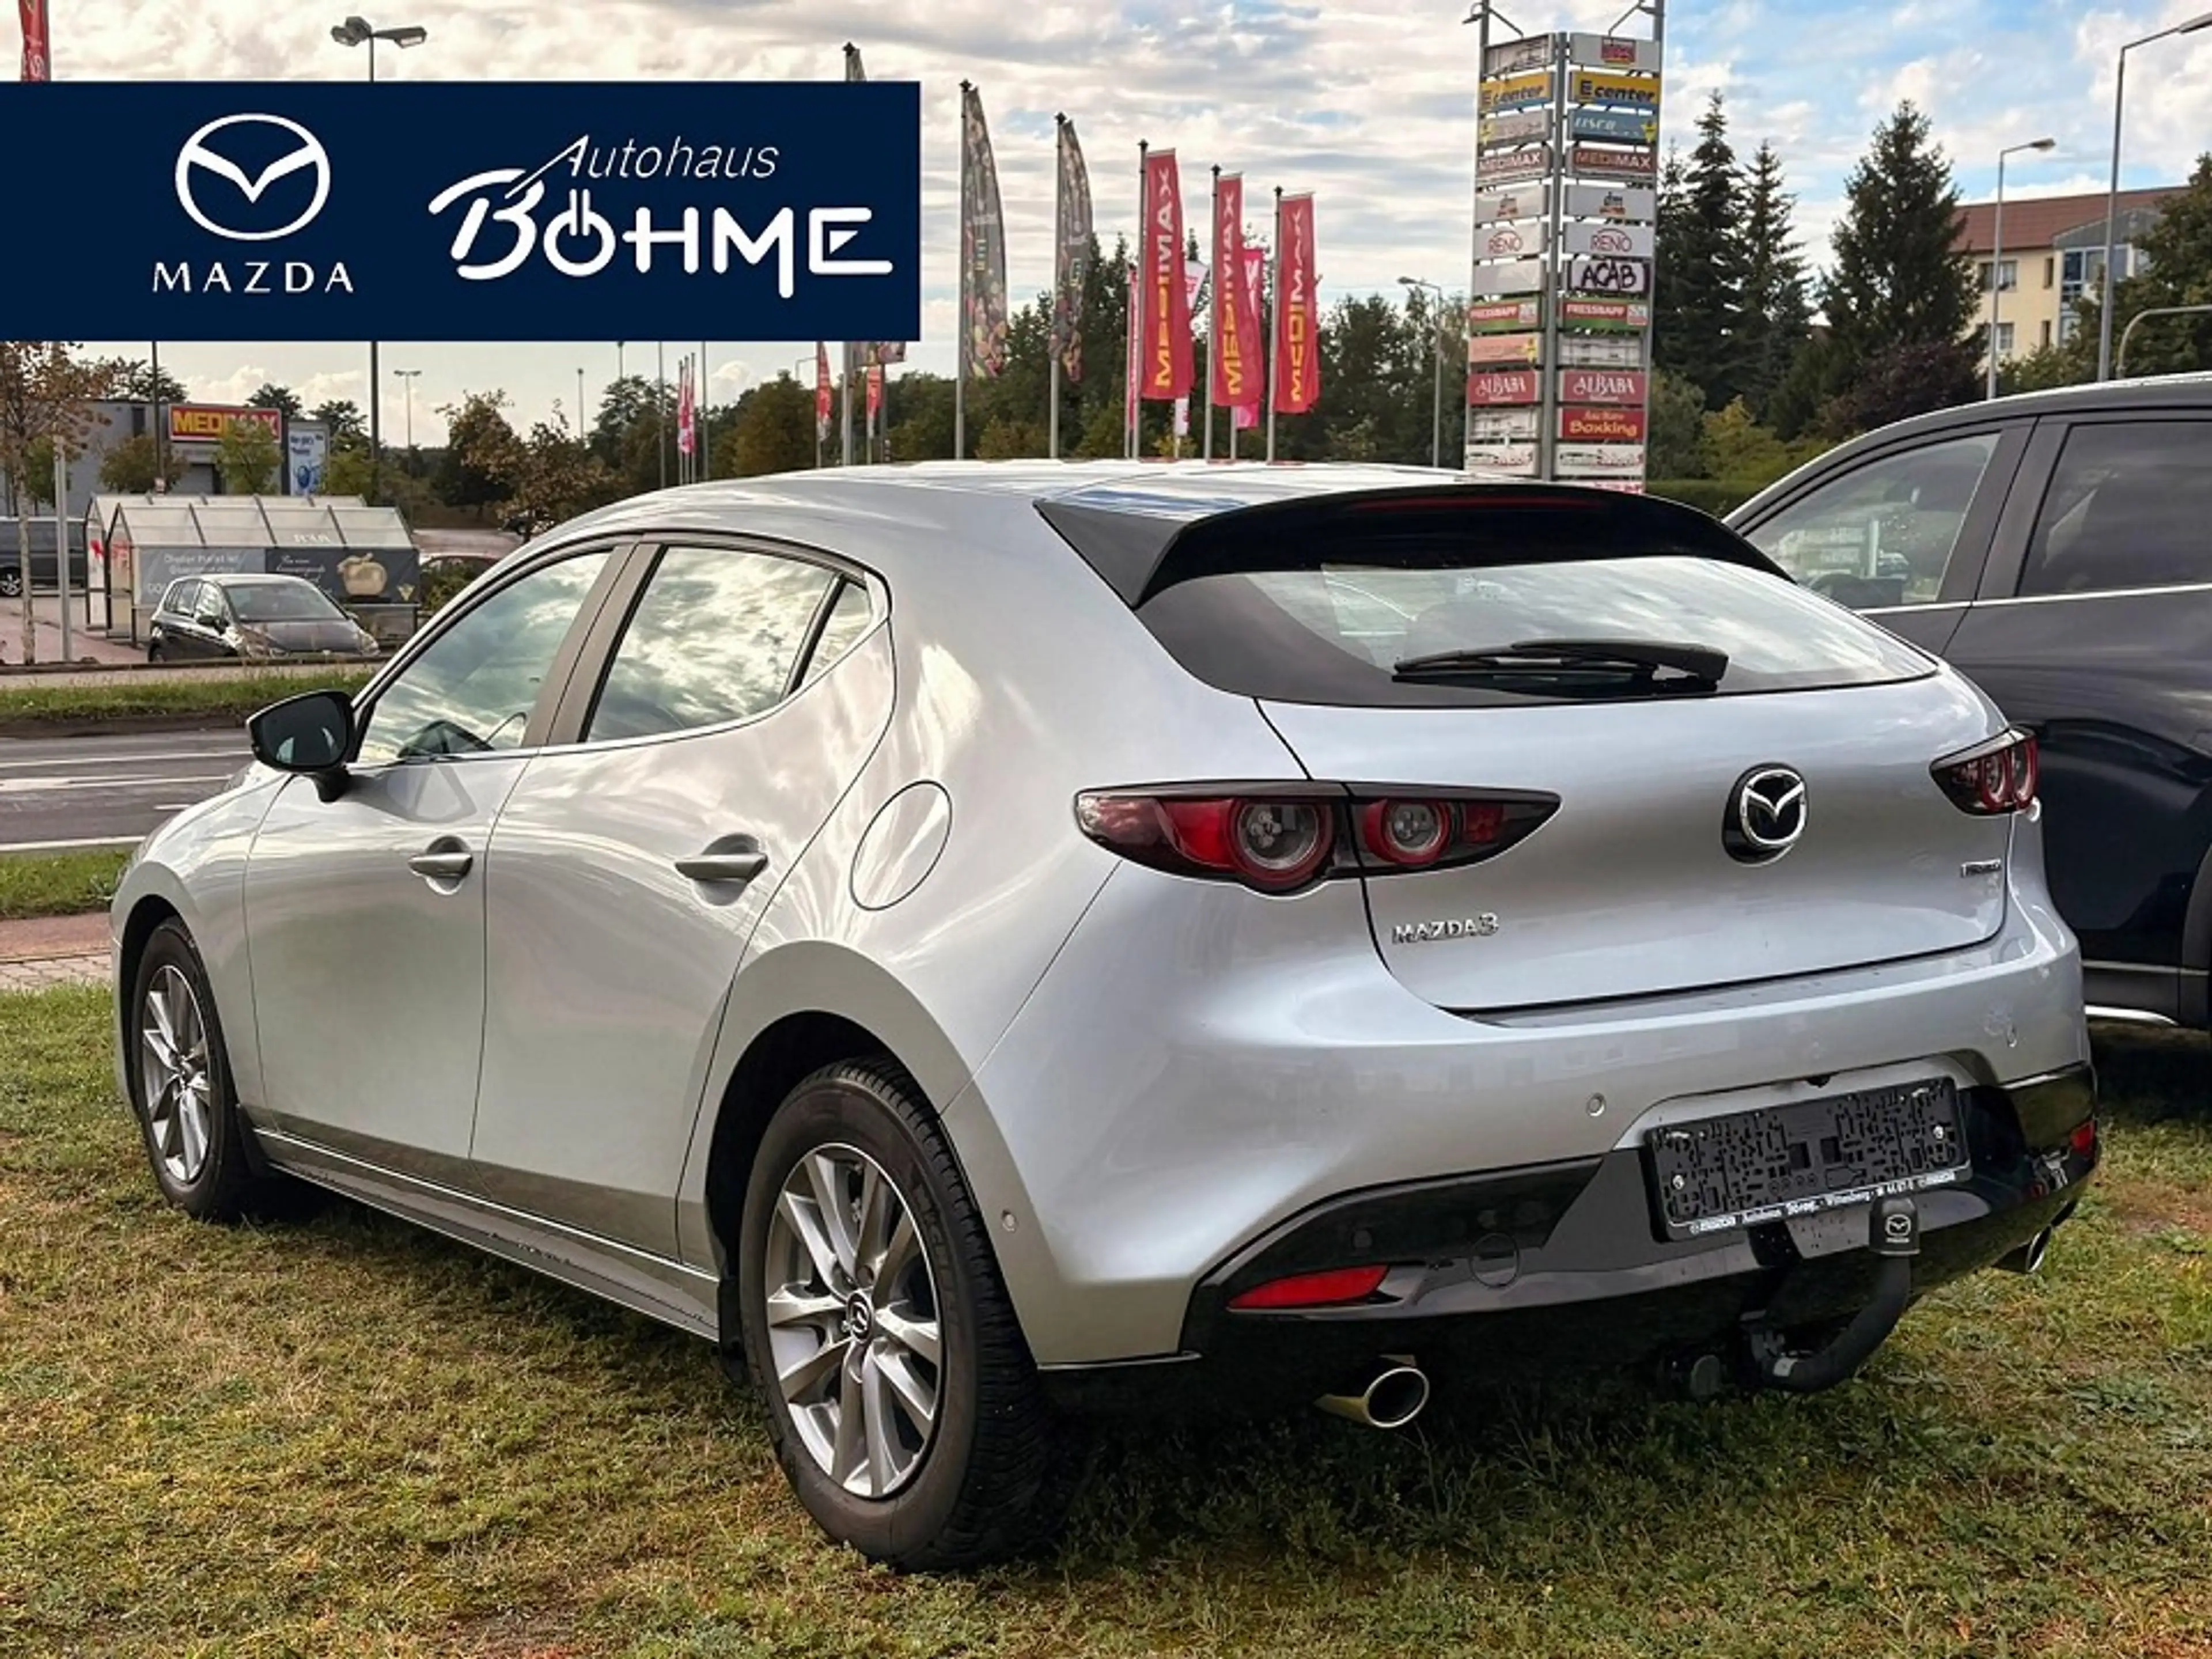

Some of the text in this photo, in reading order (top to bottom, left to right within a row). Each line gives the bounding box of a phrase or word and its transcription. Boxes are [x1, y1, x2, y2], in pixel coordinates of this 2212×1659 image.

[1594, 85, 1655, 102] center
[1590, 232, 1632, 252] RENO
[1581, 259, 1637, 289] ACAB
[1392, 912, 1499, 944] MAZDA3
